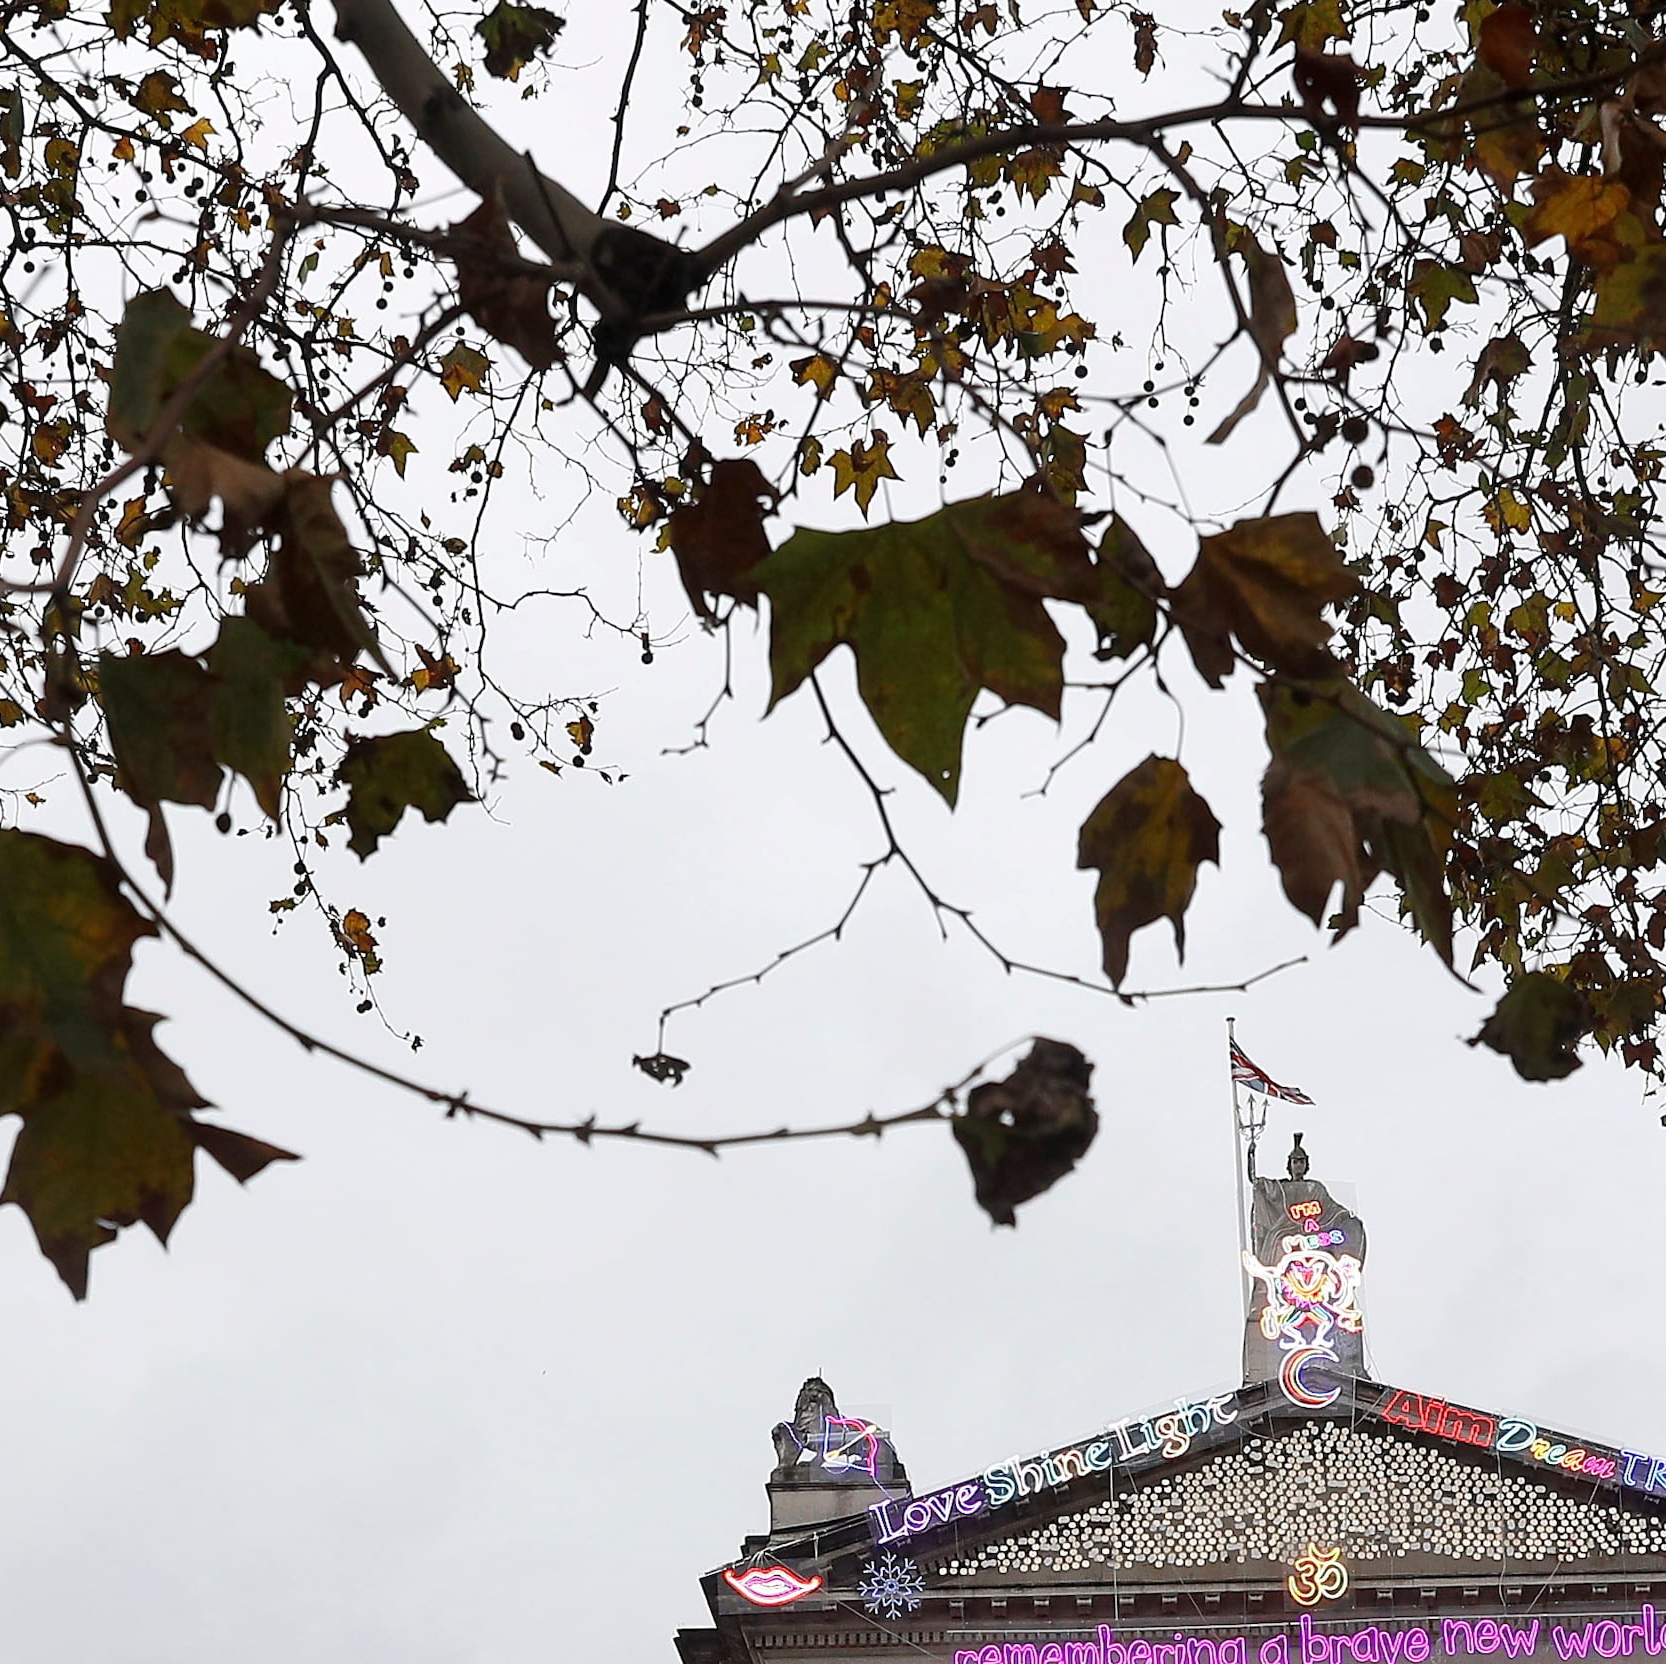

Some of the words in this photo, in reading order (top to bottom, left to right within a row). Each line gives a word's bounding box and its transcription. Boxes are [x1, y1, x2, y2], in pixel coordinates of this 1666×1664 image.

[1282, 1229, 1345, 1253] MESS
[1305, 1218, 1320, 1232] A
[1381, 1389, 1496, 1448] Aim
[1496, 1416, 1617, 1480] Dream
[868, 1482, 982, 1545] Love
[984, 1441, 1112, 1506] Shine
[1108, 1393, 1239, 1462] Light
[1442, 1617, 1539, 1659] new
